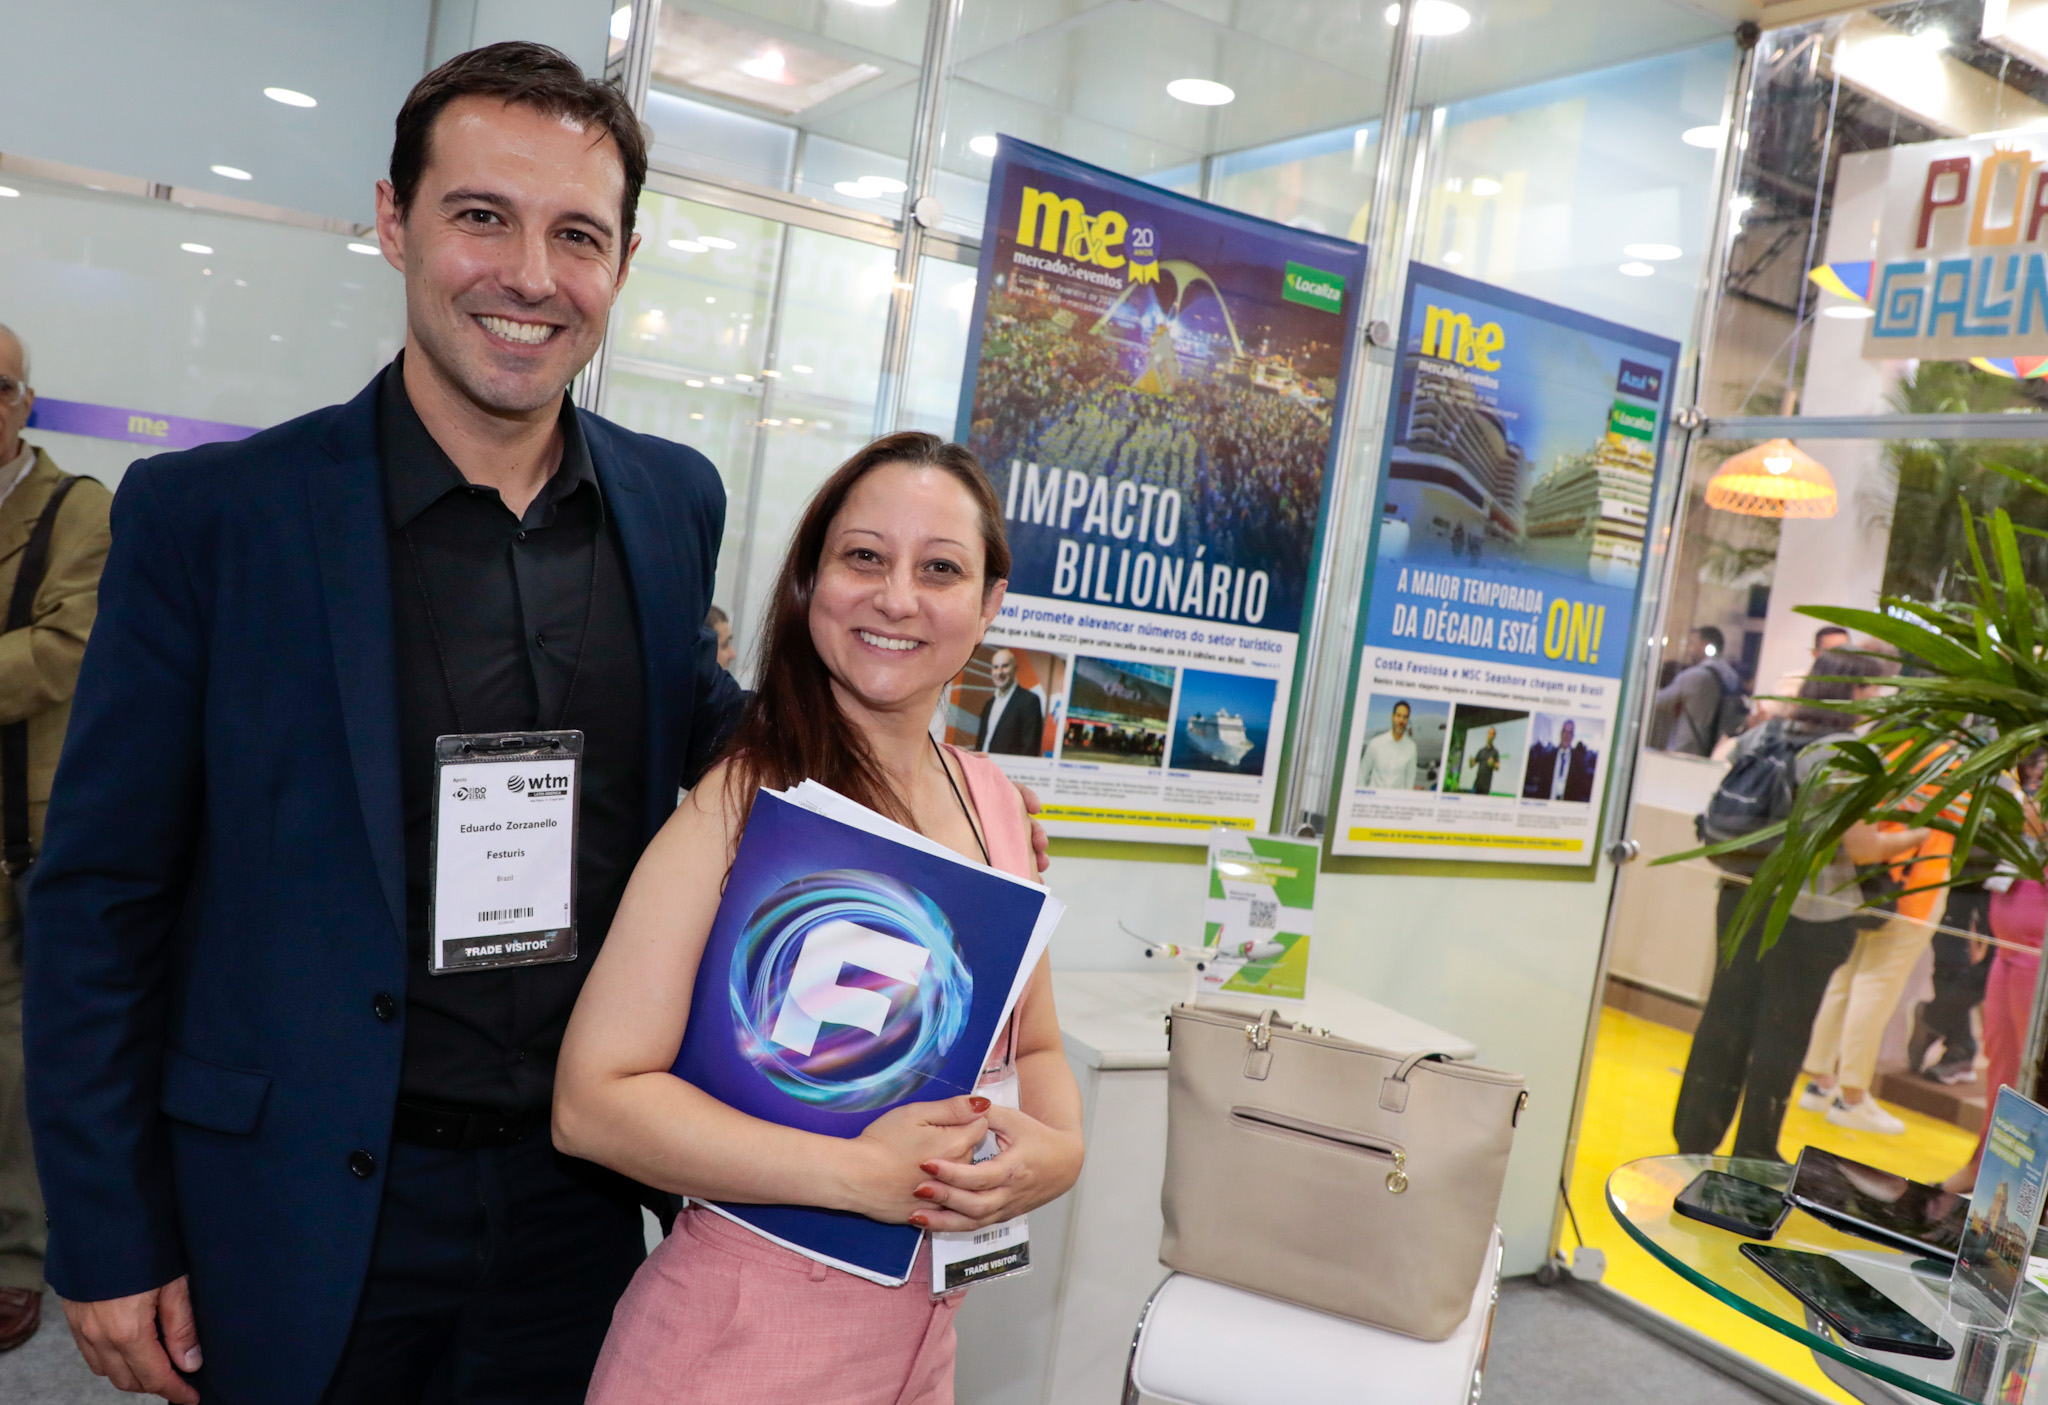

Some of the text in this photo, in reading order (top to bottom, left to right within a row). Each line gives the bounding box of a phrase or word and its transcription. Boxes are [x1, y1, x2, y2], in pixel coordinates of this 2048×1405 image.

[1132, 227, 1154, 248] 20
[1294, 275, 1342, 302] Localiza
[1005, 459, 1181, 547] IMPACTO
[1053, 539, 1270, 624] BILIONÁRIO
[1397, 568, 1543, 615] A MAIOR TEMPORADA
[1021, 608, 1075, 625] promete
[1078, 614, 1135, 633] alavancar
[1137, 622, 1187, 641] números
[1190, 630, 1205, 643] do
[1207, 632, 1236, 647] setor
[1239, 637, 1283, 653] turístico
[1392, 602, 1539, 655] DA DÉCADA ESTÁ
[1543, 597, 1606, 665] ON!
[1374, 657, 1403, 672] Costa
[1462, 668, 1482, 681] MSC
[528, 773, 568, 790] wtm
[460, 818, 557, 834] Eduardo Zorzanello
[486, 848, 525, 860] Festuris
[496, 874, 514, 882] Brazil
[465, 939, 548, 957] TRADE VISITOR
[964, 1253, 1018, 1277] TRADE VISITOR
